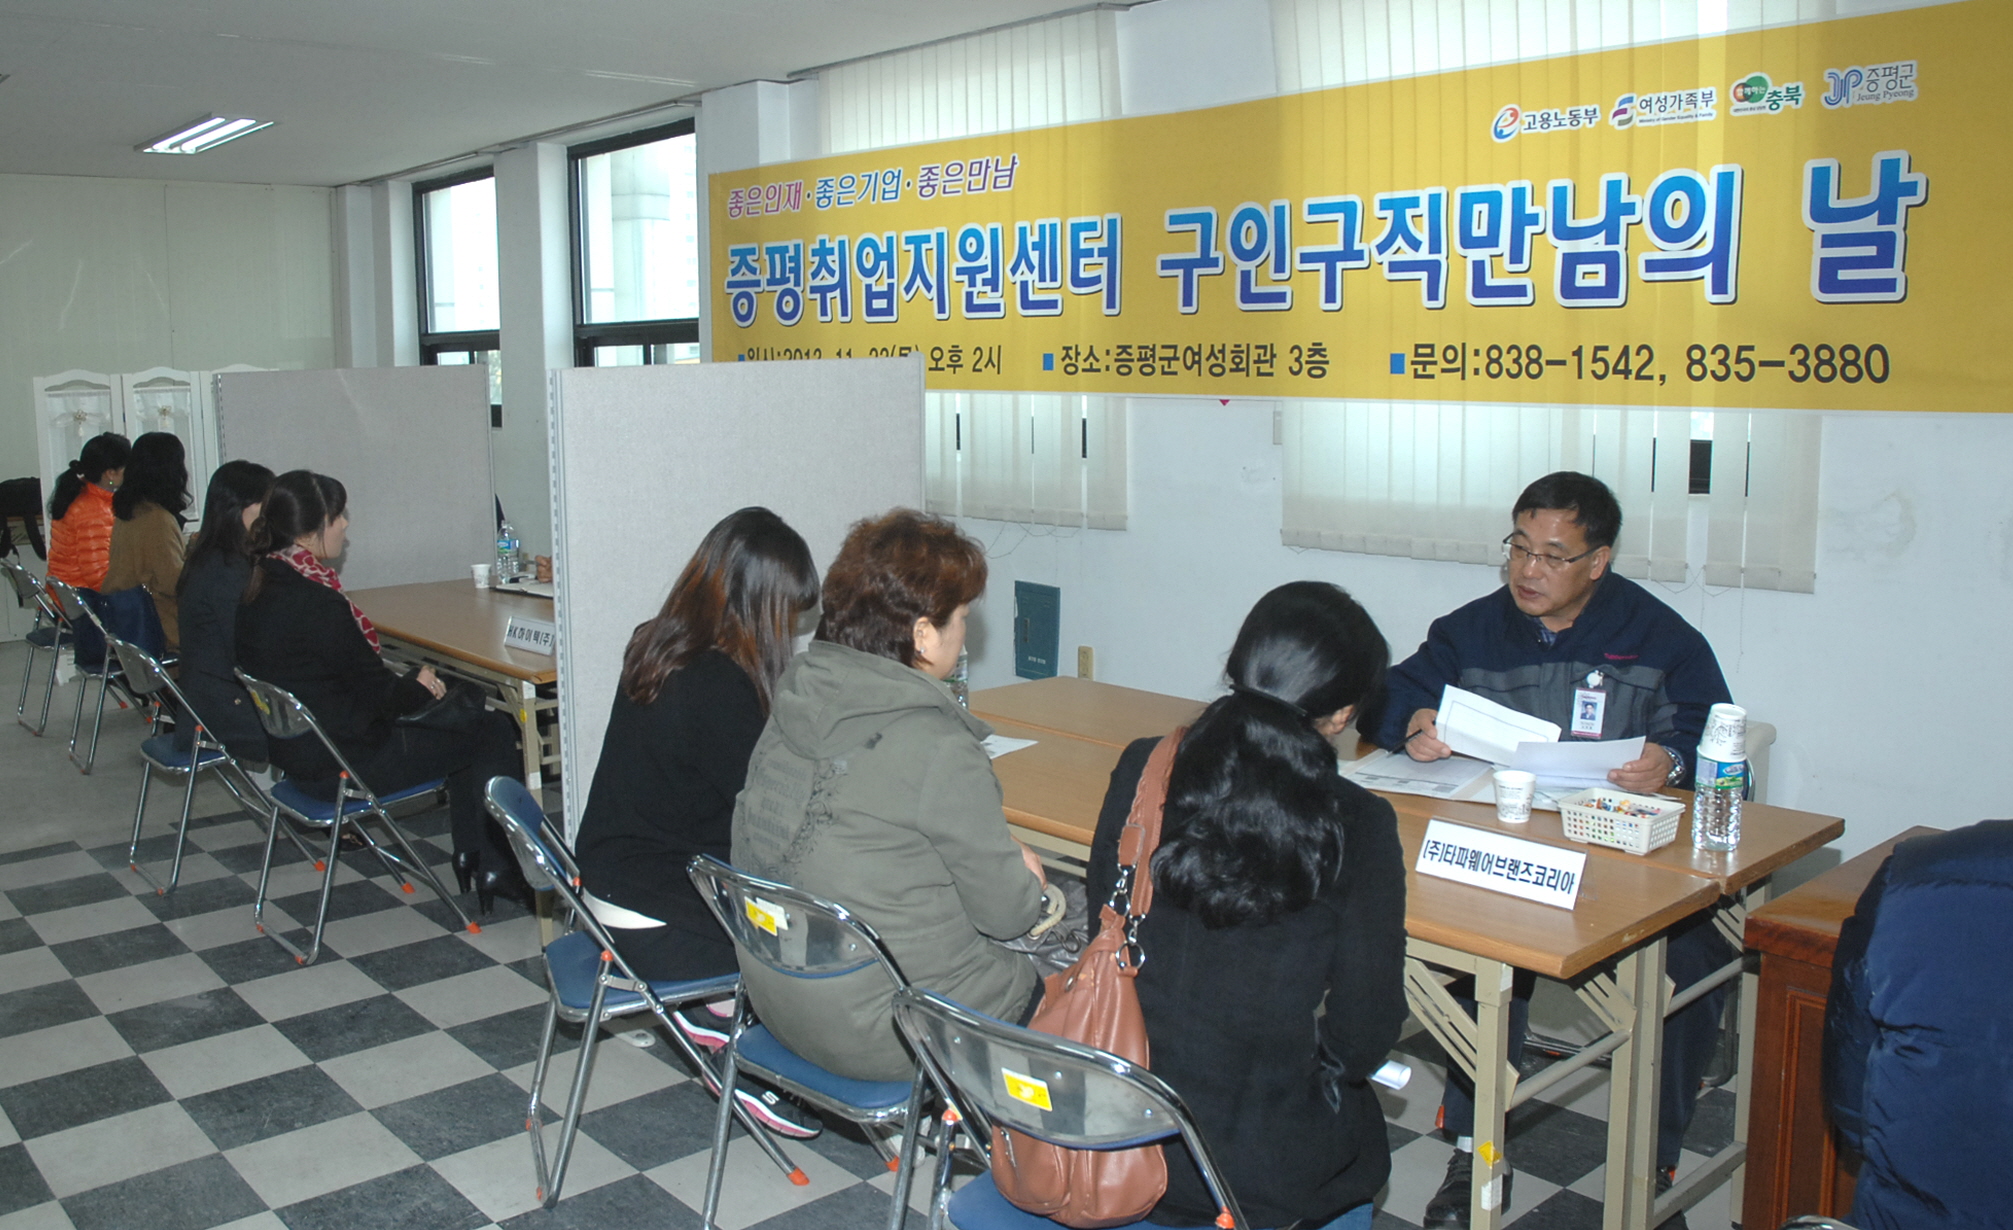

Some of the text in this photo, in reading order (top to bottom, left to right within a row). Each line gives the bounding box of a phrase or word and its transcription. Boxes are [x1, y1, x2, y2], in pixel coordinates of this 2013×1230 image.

[1866, 63, 1914, 93] 증평군
[1639, 90, 1715, 114] 여성가족부
[1766, 85, 1802, 111] 충북
[1857, 89, 1915, 102] Jeung Pyeong
[1523, 107, 1598, 131] 고용노동부
[725, 150, 1927, 326] 증평취업지원센터 구인구직만남의 날
[928, 344, 963, 375] 오후
[971, 344, 1002, 375] 2시
[1060, 342, 1330, 379] 장소:증평군여성회관 3층
[1411, 342, 1890, 386] 문의:838-1542, 835-3880
[1422, 839, 1576, 895] (주)타파웨어브랜즈코리아
